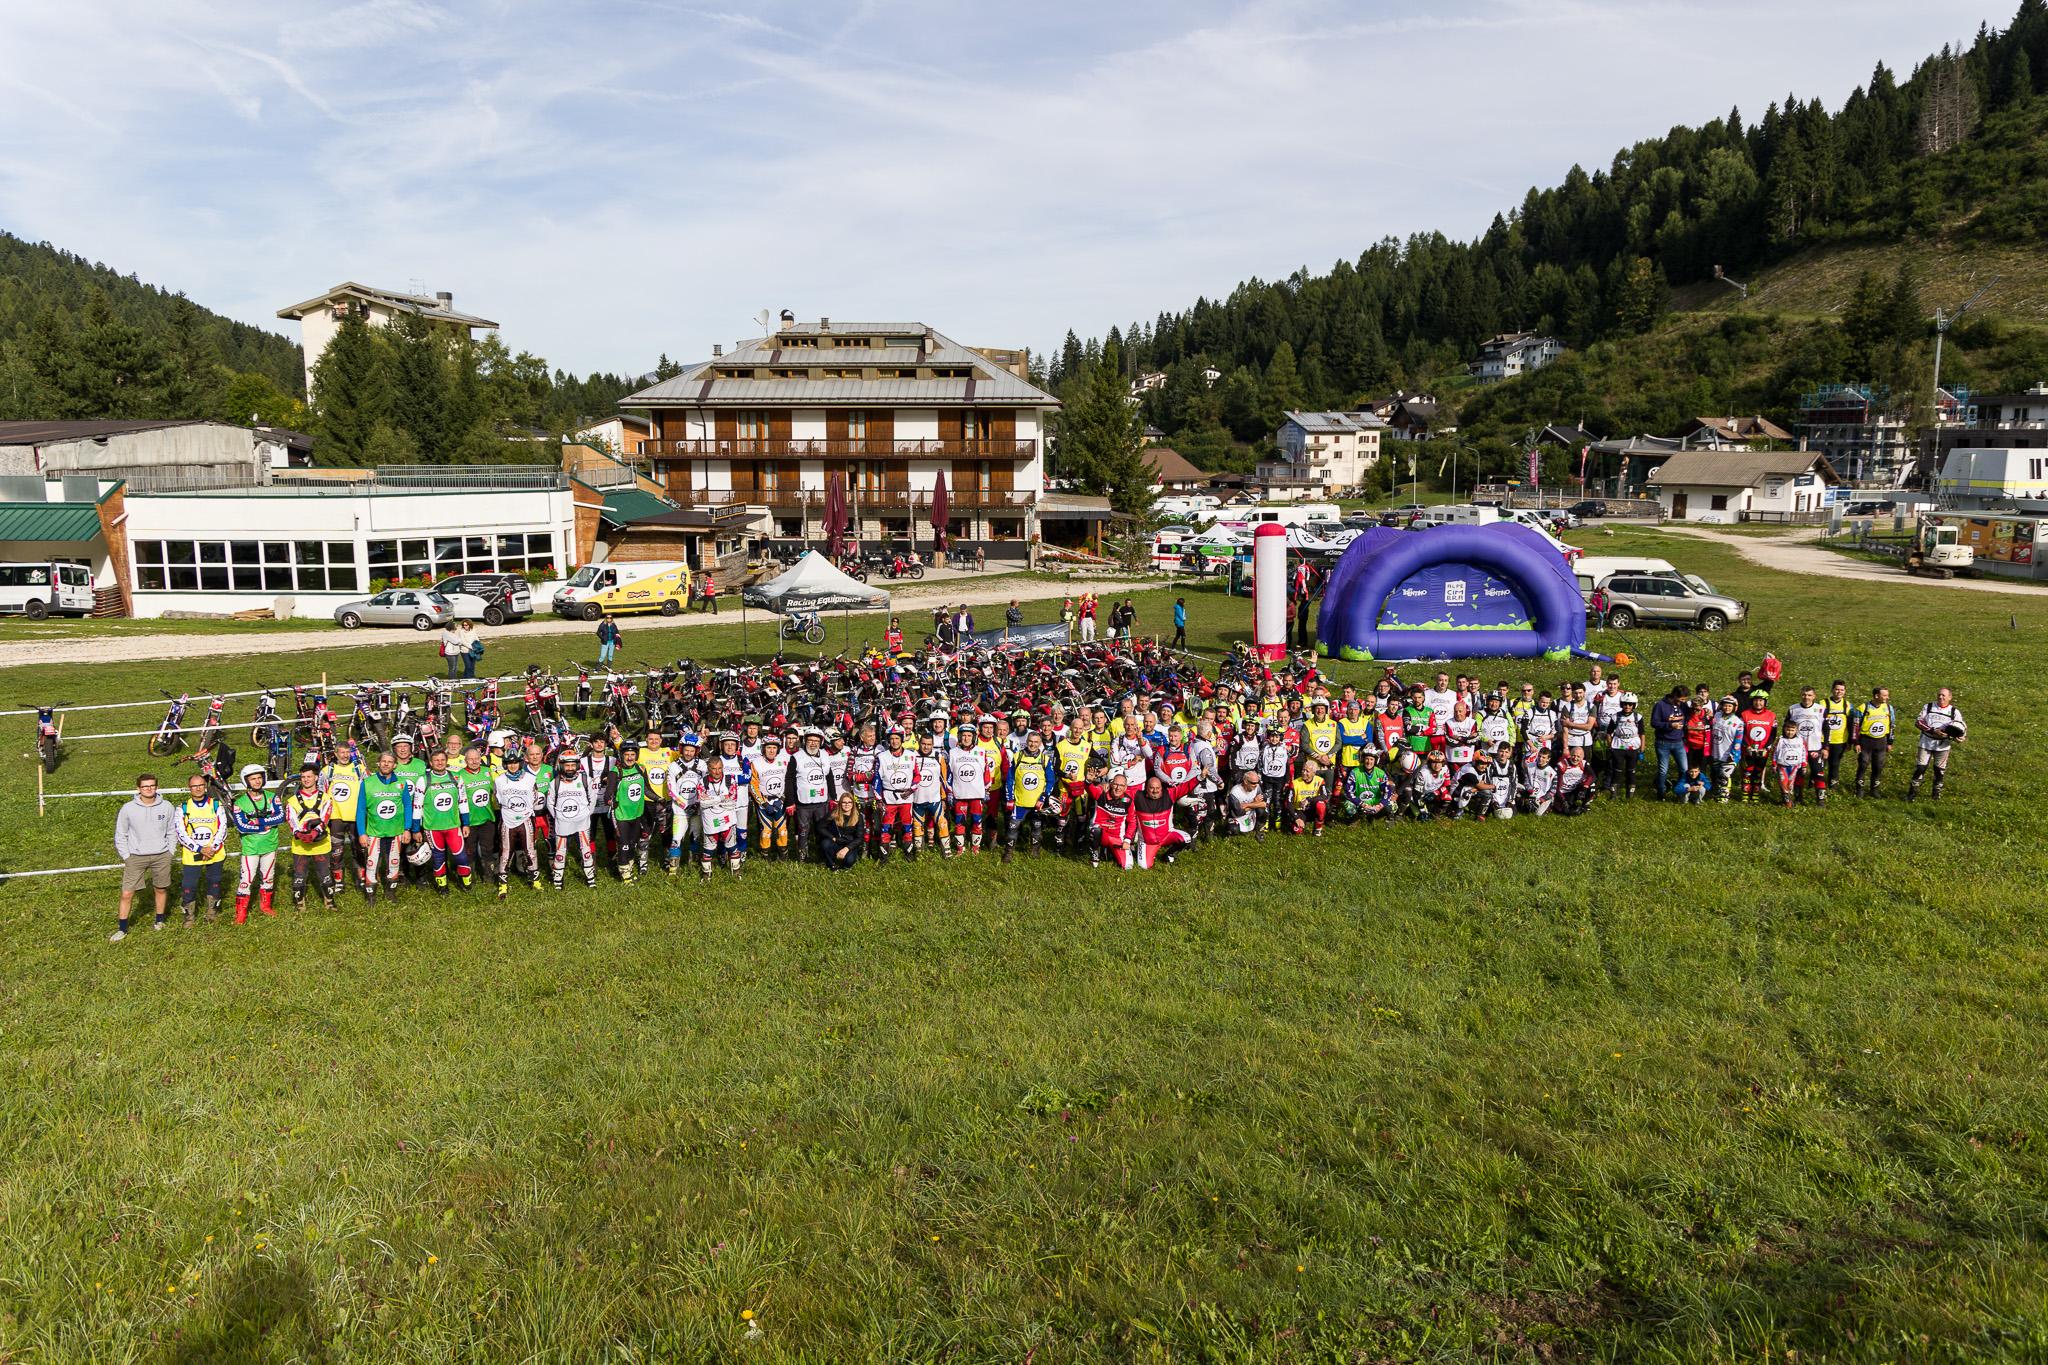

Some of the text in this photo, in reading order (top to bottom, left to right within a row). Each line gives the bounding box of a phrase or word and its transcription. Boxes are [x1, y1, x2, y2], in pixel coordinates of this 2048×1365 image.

[786, 594, 862, 608] Racing Equipment
[1066, 764, 1078, 773] 92
[334, 788, 348, 796] 75
[629, 788, 641, 796] 32
[475, 793, 488, 803] 28
[436, 798, 452, 807] 29
[380, 806, 395, 814] 25
[194, 832, 211, 840] 113
